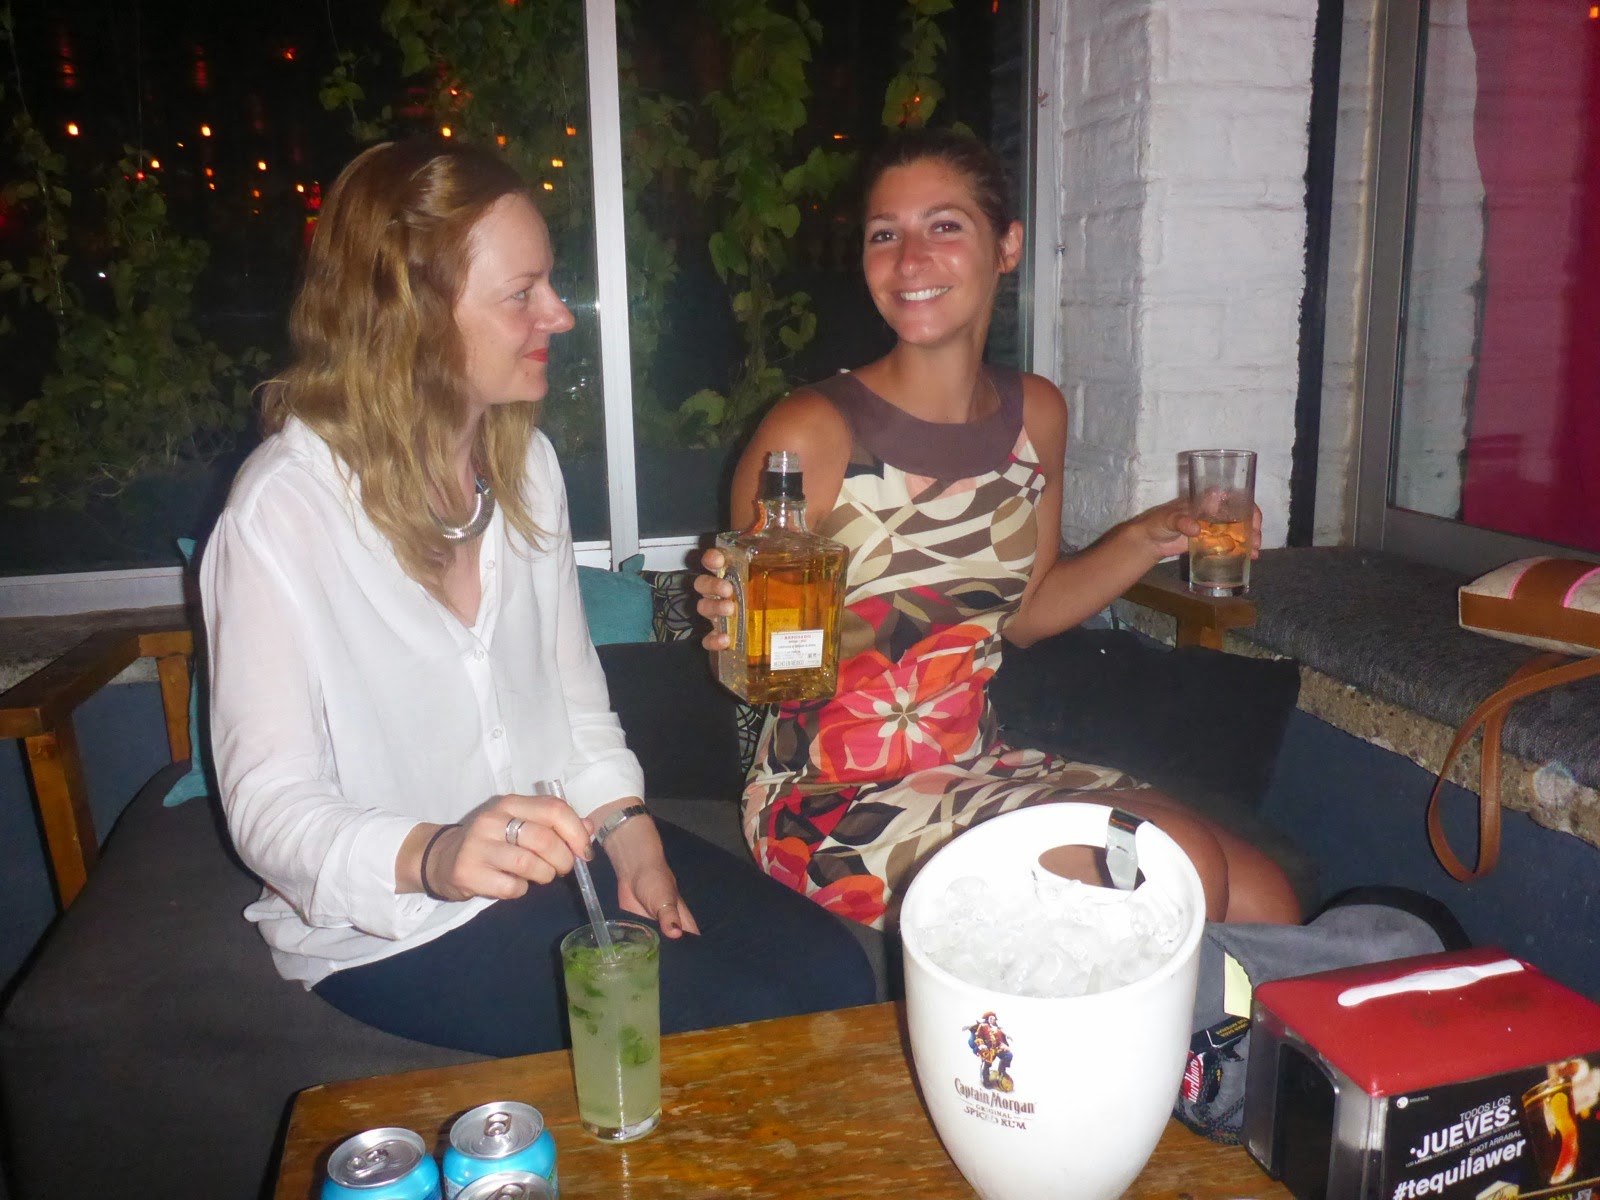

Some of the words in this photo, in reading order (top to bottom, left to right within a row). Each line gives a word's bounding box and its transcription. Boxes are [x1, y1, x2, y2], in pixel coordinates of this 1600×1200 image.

[954, 1077, 991, 1106] Captain
[990, 1092, 1035, 1115] Morgan
[1459, 1102, 1490, 1121] TODOS
[1492, 1095, 1511, 1109] LOS
[1469, 1142, 1488, 1156] SHOT
[1488, 1129, 1522, 1148] ARRABAL
[1393, 1139, 1526, 1200] #tequilawer
